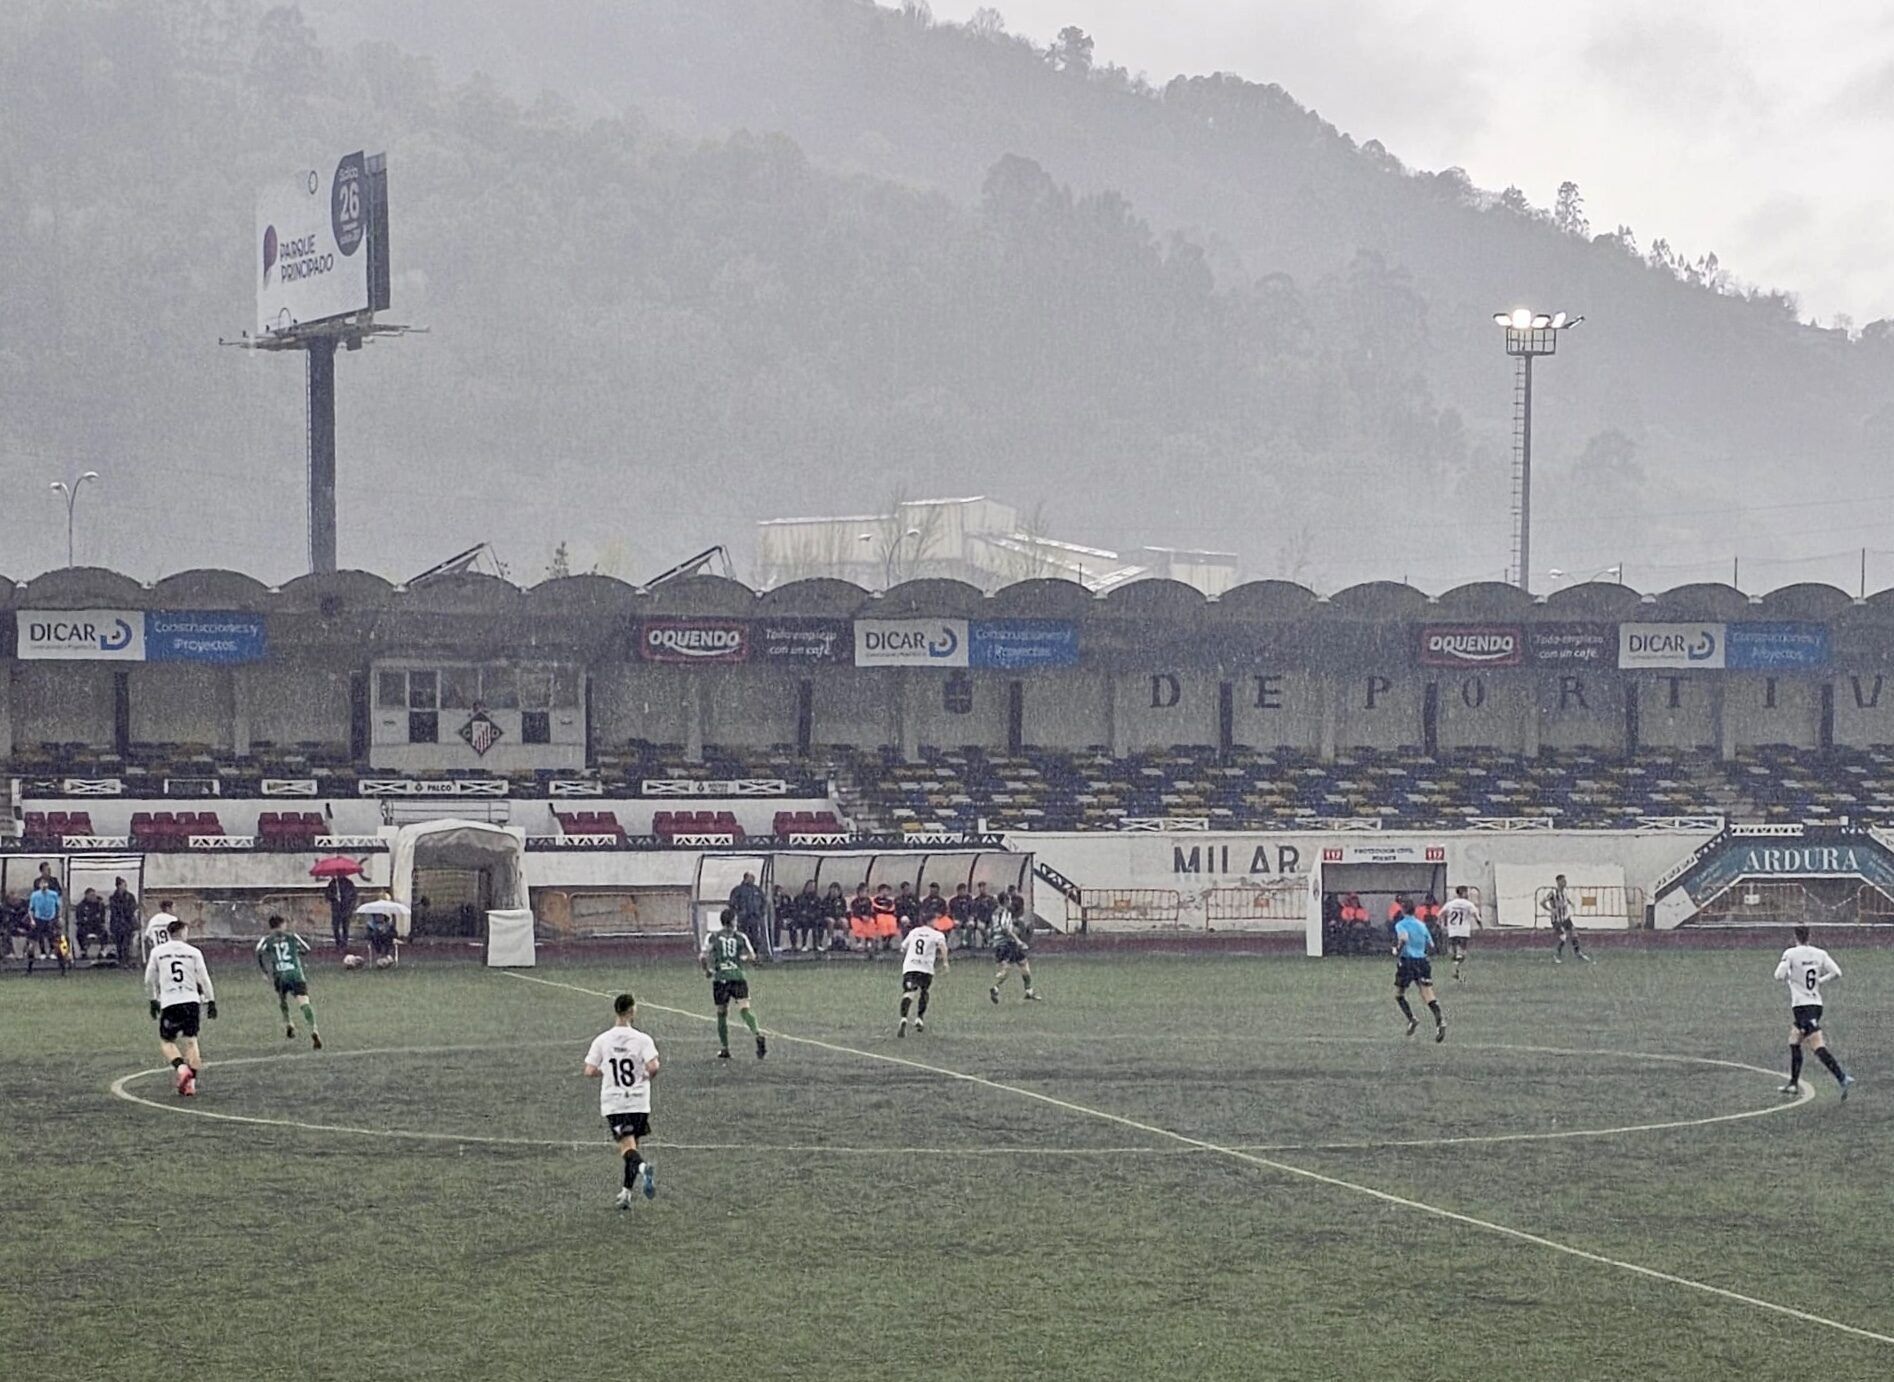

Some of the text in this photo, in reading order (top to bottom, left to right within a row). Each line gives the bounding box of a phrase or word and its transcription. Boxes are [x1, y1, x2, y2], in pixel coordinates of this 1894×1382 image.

[340, 182, 360, 221] 26
[281, 253, 334, 283] PRINCIPADO
[30, 623, 96, 641] DICAR
[648, 630, 741, 656] OQUENDO
[866, 631, 926, 650] DICAR
[1629, 633, 1685, 652] DICAR
[1429, 635, 1514, 659] OQUENDO
[1427, 850, 1444, 860] 112
[1743, 847, 1861, 871] ARDURA
[1450, 911, 1463, 926] 21
[154, 930, 168, 945] 19
[273, 942, 292, 961] 12
[171, 961, 184, 983] 5
[1806, 969, 1816, 991] 6
[609, 1058, 636, 1088] 18
